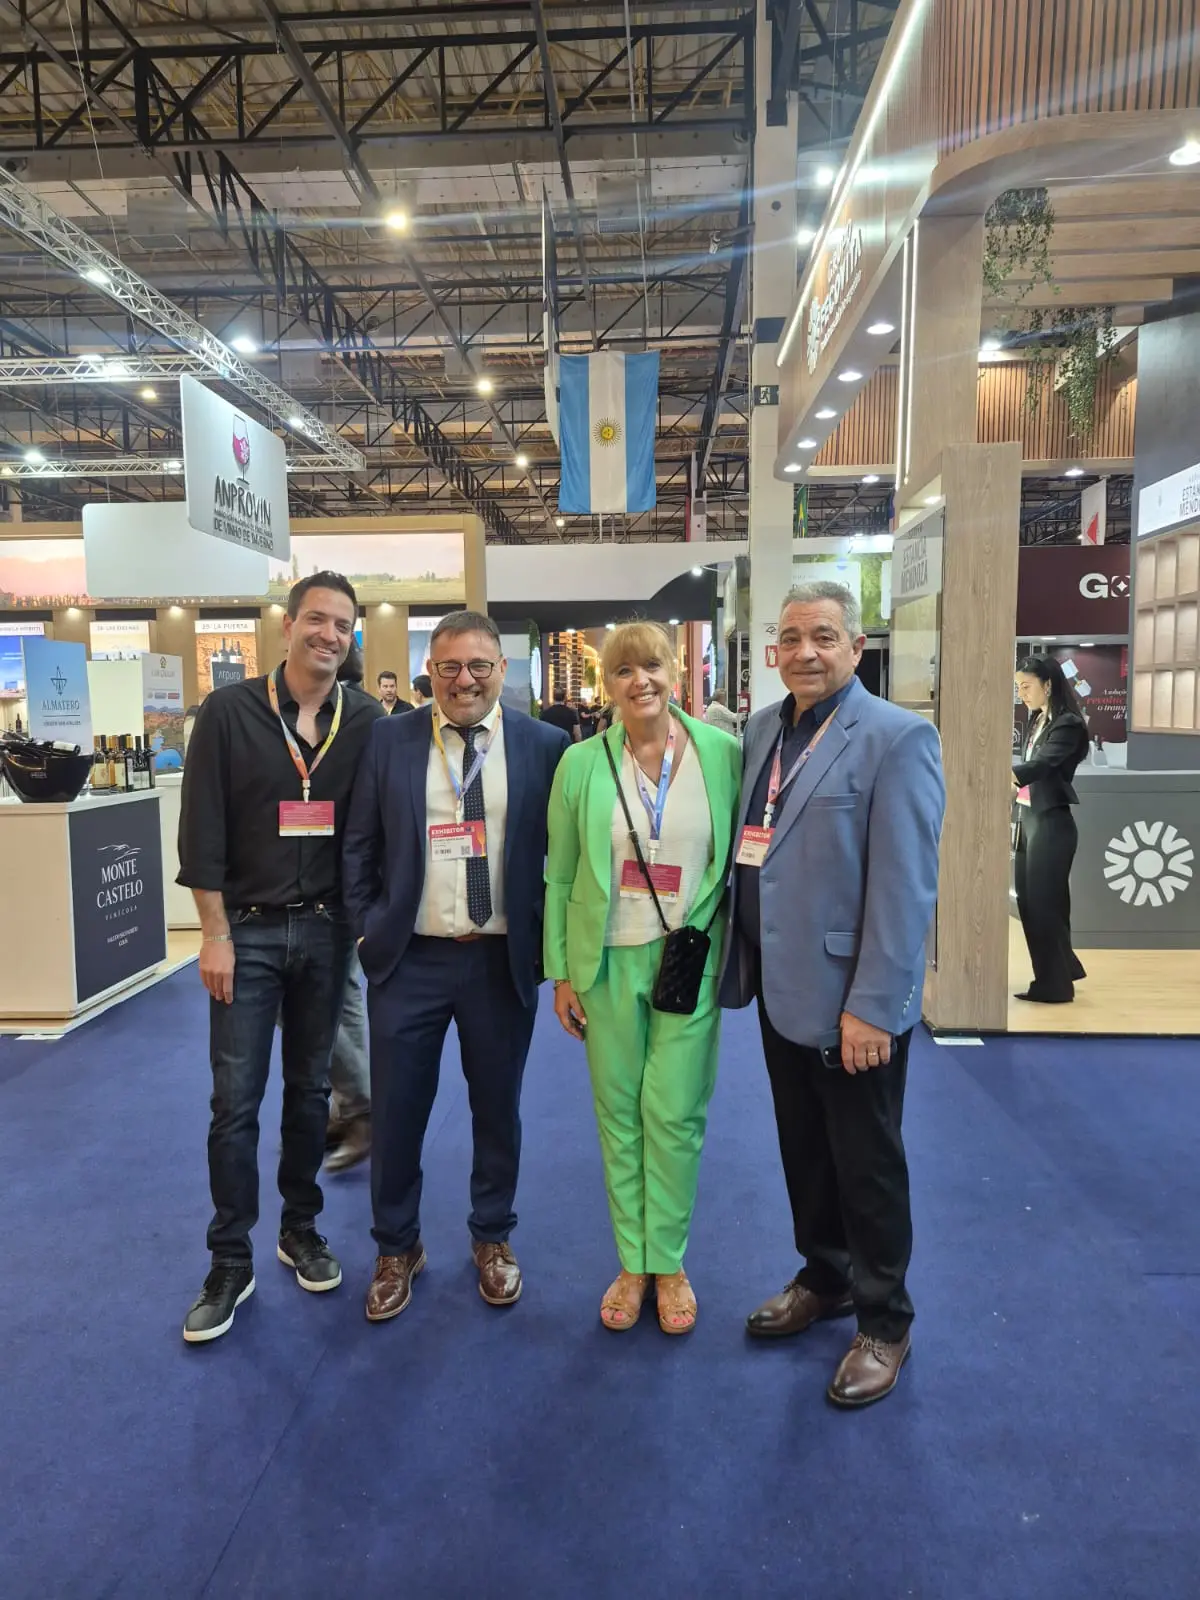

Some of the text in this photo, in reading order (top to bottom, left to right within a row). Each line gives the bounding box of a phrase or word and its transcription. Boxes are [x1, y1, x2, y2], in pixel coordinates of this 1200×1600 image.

[214, 475, 271, 526] ANPROVIN
[101, 858, 138, 885] MONTE
[96, 879, 143, 909] CASTELO
